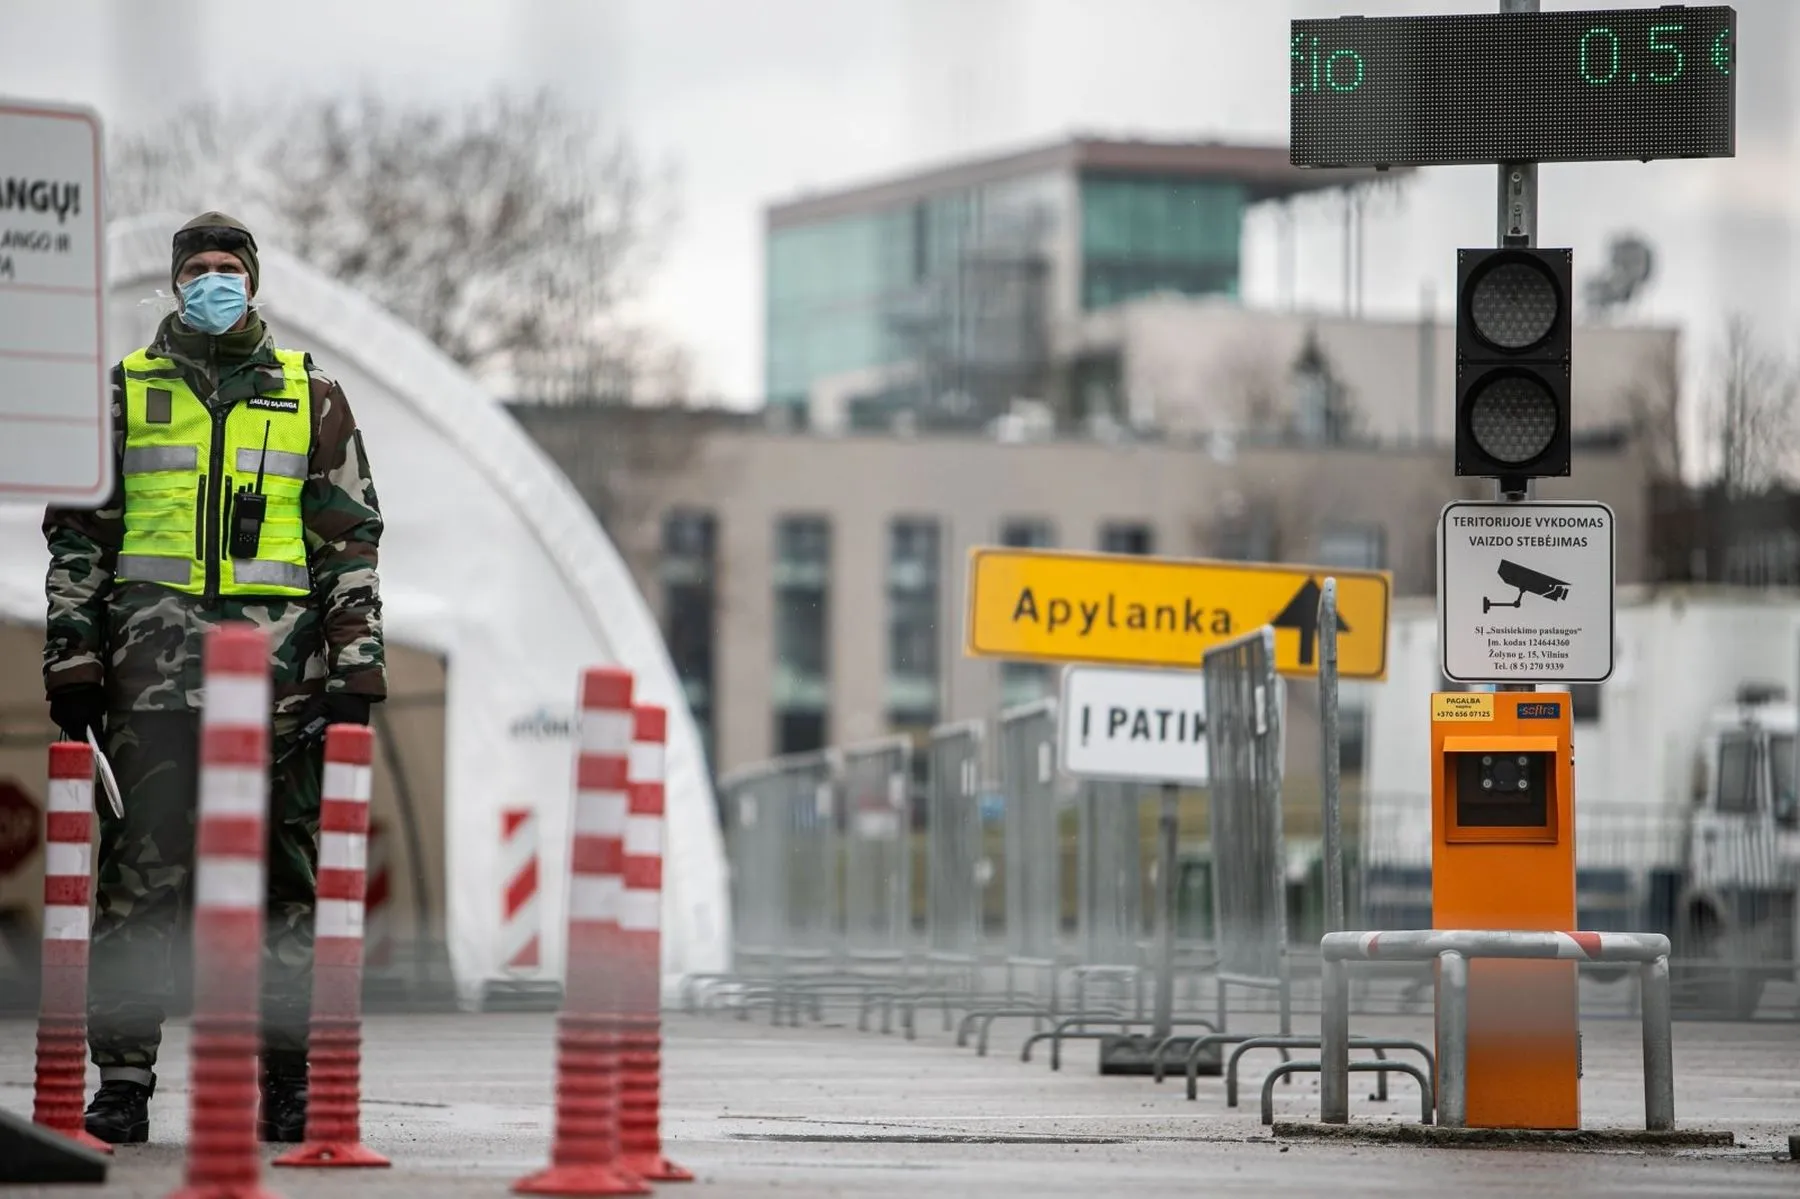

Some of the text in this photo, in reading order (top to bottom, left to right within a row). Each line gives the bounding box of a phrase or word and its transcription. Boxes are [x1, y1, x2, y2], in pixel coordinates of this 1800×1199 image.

[1580, 23, 1684, 84] 0.5
[0, 176, 80, 223] NGŲ!
[1453, 516, 1604, 528] TERITORIJOJE VYKDOMAS
[1469, 534, 1588, 547] VAIZDO STEBĖJIMAS
[1012, 588, 1233, 636] Apylanka
[1503, 639, 1526, 647] kodas
[1529, 639, 1570, 647] 124644360
[1541, 651, 1569, 659] Vilnius
